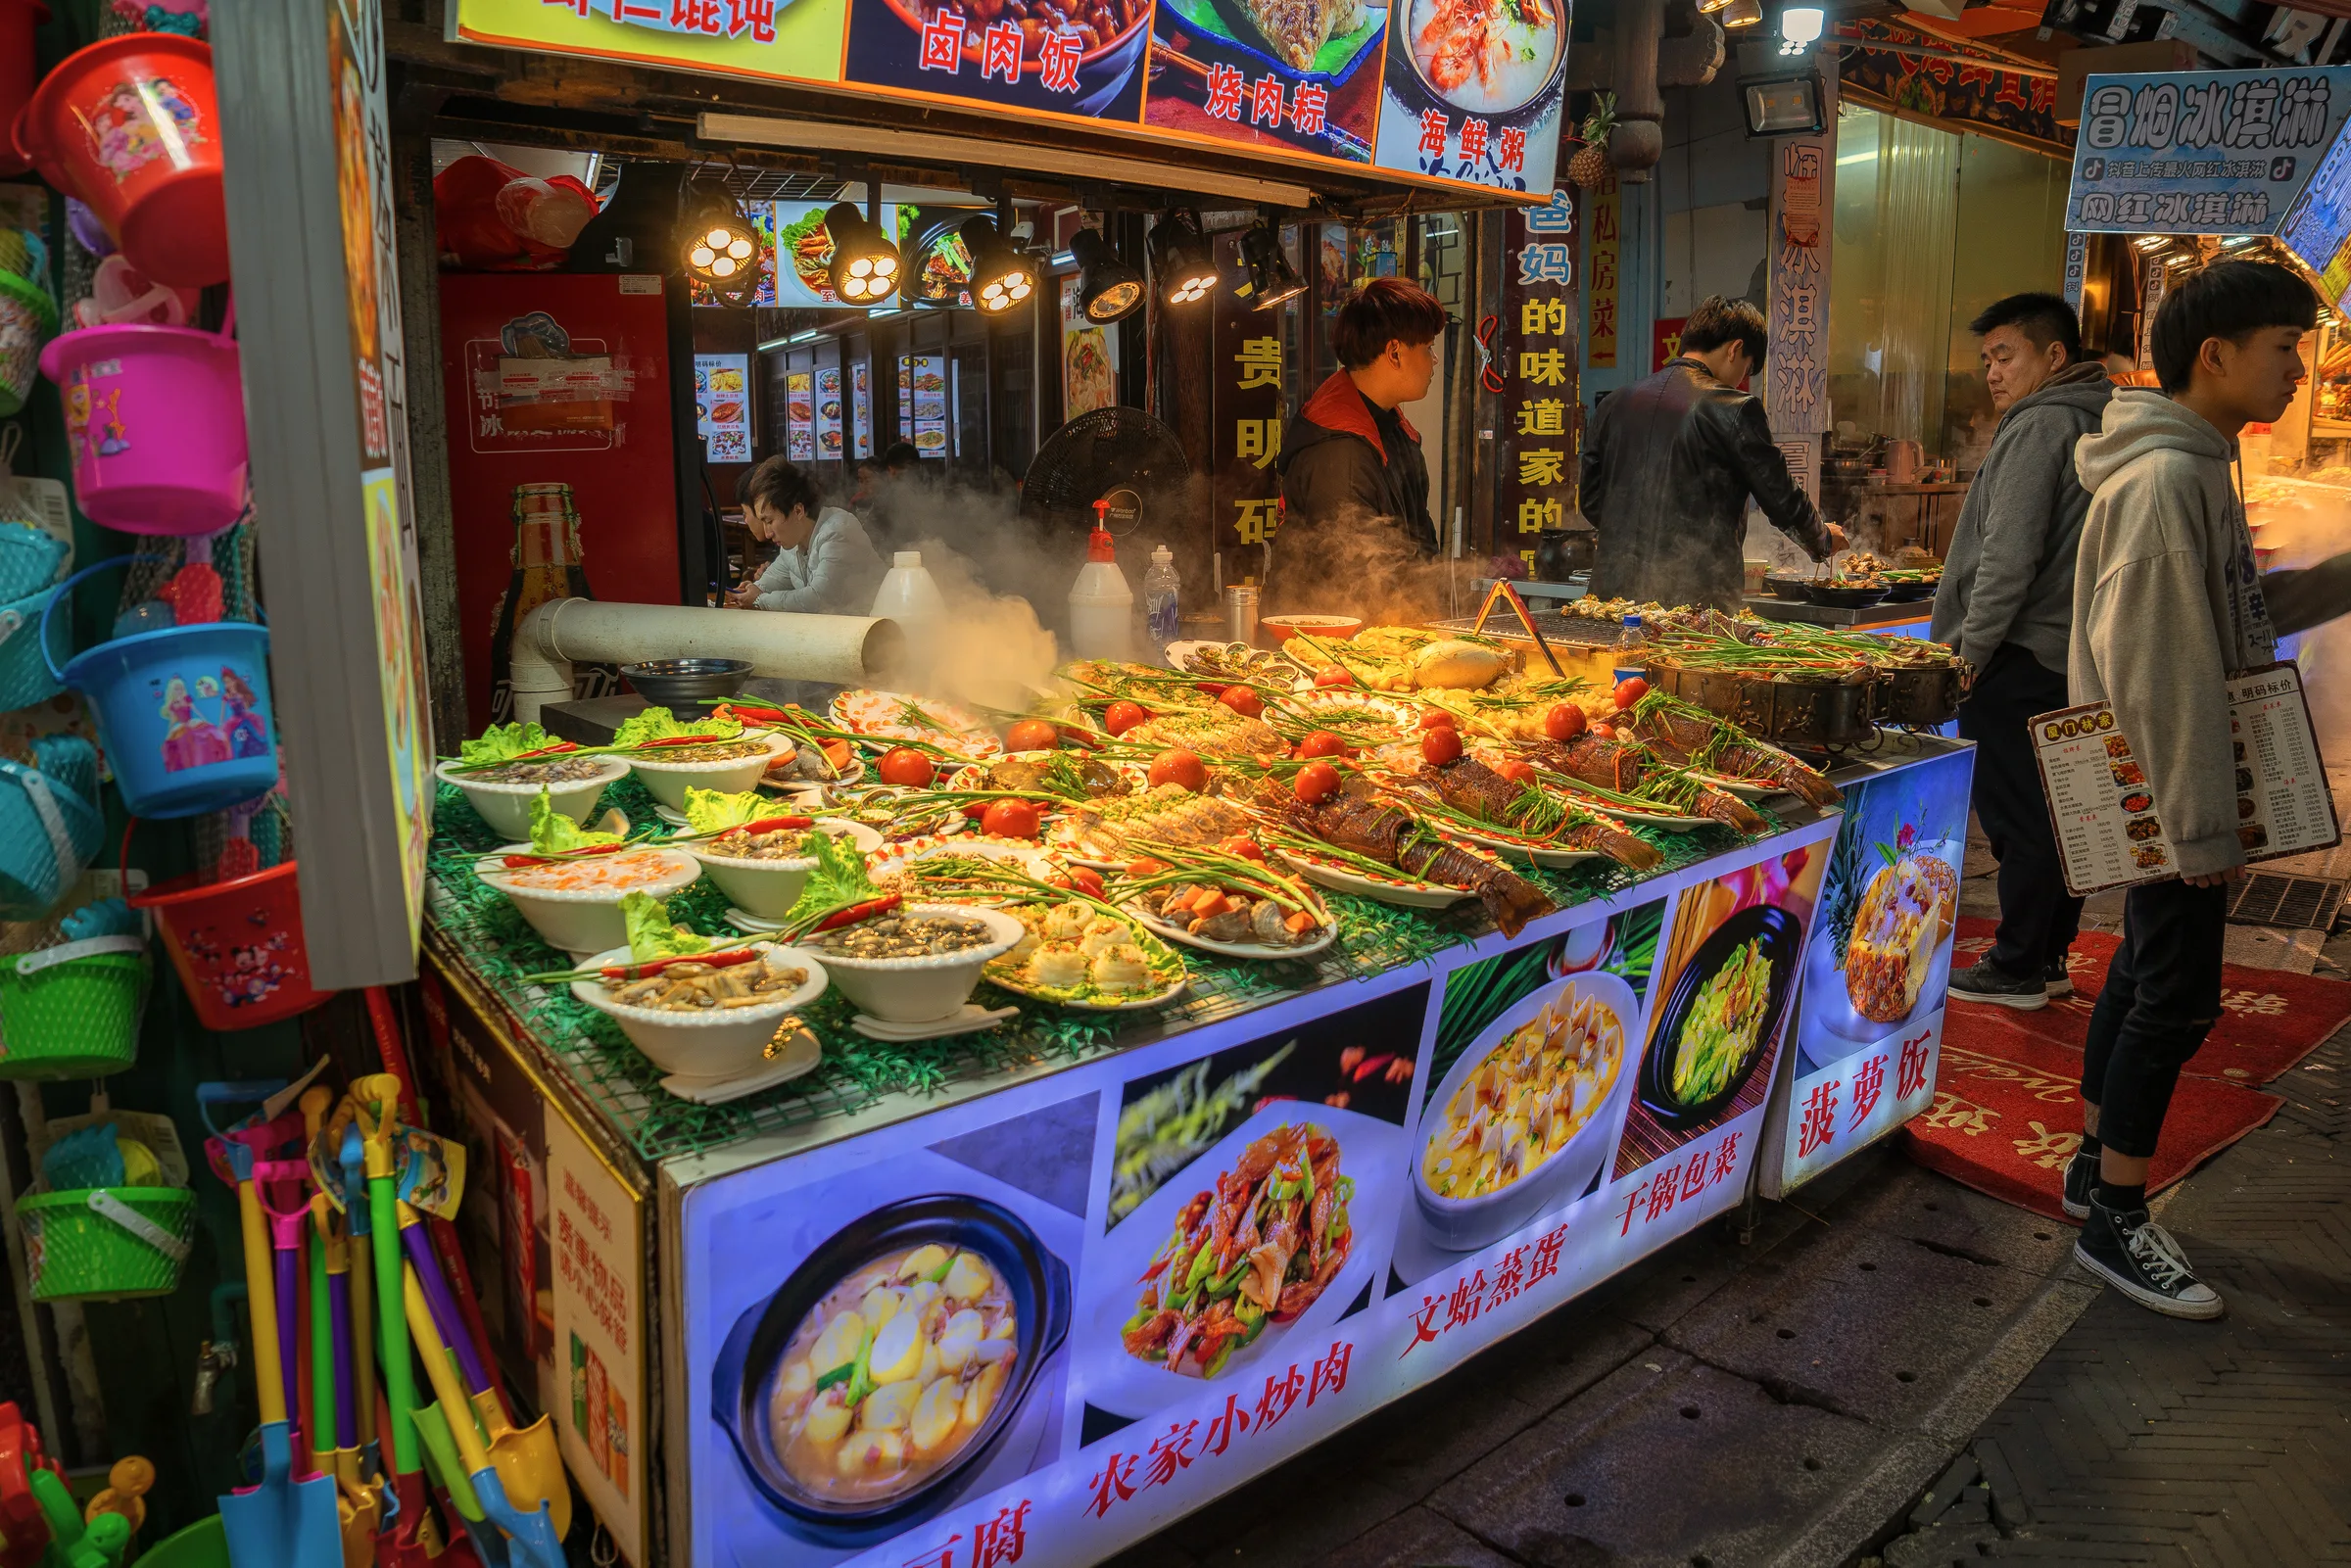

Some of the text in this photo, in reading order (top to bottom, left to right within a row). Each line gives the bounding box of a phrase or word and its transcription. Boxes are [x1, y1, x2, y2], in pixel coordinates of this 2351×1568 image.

[919, 9, 1083, 93] 卤肉饭
[1205, 62, 1329, 135] 烧肉粽
[2087, 75, 2331, 149] 冒烟冰淇淋
[1417, 109, 1526, 170] 海鲜粥
[2107, 160, 2267, 178] 抖音上传最火网红冰淇淋
[2080, 192, 2270, 224] 网红冰淇淋
[1516, 189, 1573, 568] 爸妈的味道家的
[2046, 712, 2112, 739] 厦门林家
[2242, 678, 2291, 699] 明码标价
[1798, 1029, 1933, 1160] 菠萝饭
[1614, 1131, 1744, 1237] 干锅包菜
[556, 1209, 628, 1322] 贵重物品
[1399, 1222, 1572, 1360] 文蛤蒸蛋
[1082, 1341, 1354, 1519] 农家小炒肉
